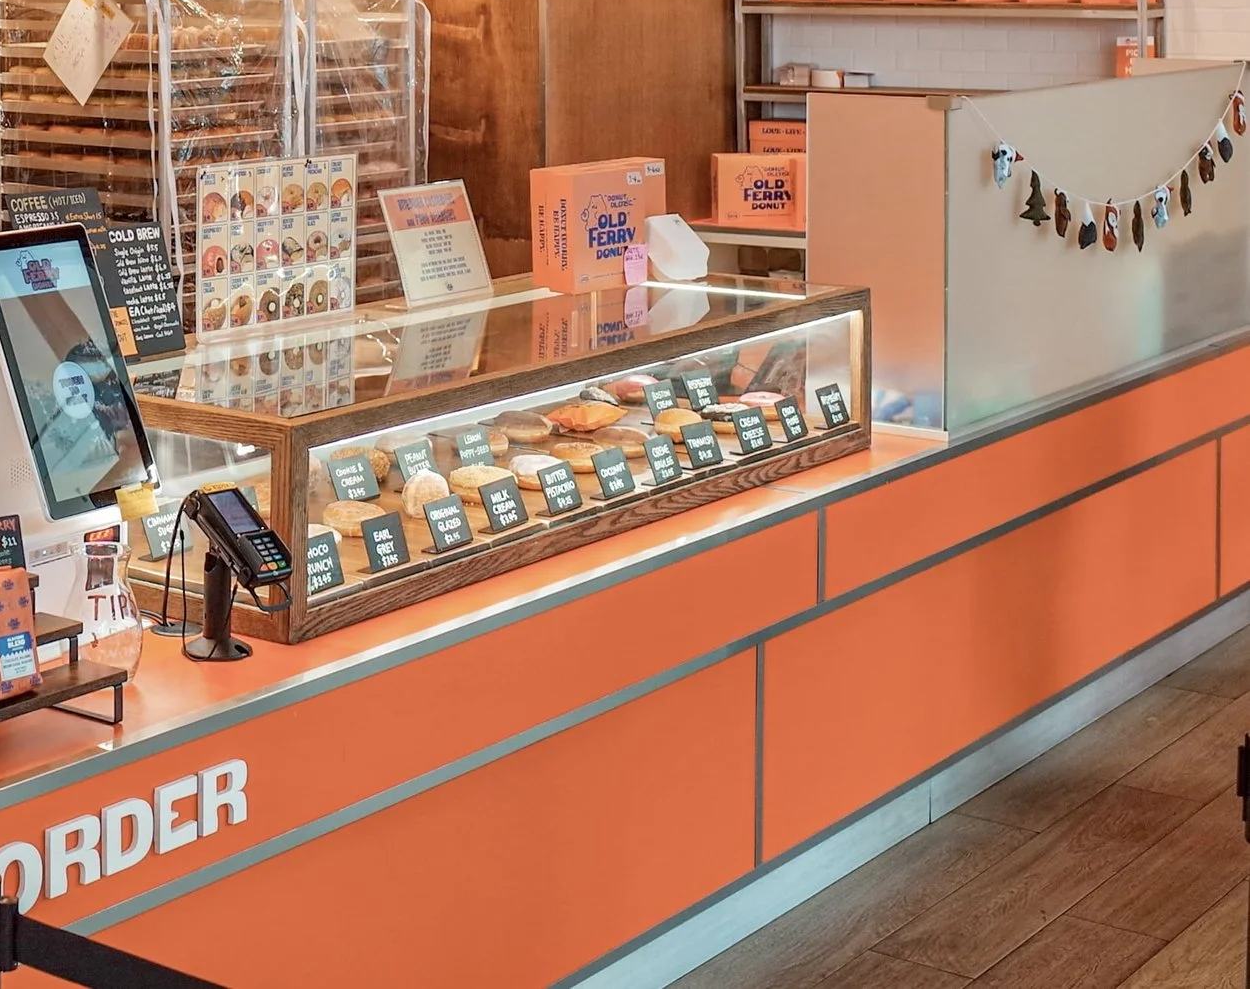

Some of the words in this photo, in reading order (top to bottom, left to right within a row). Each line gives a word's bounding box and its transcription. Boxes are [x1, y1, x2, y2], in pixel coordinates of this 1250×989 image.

[753, 179, 785, 190] OLD
[744, 187, 793, 201] FERRY
[10, 195, 48, 212] COFFEE
[751, 202, 786, 210] DONUT
[14, 212, 49, 224] ESPRESSO
[597, 211, 628, 230] OLD
[109, 229, 135, 243] COLD
[136, 227, 161, 241] BREW
[588, 227, 636, 248] FERRY
[739, 416, 761, 428] CREAM
[405, 449, 427, 464] PEANUT
[335, 466, 358, 477] COOKIE
[544, 468, 568, 485] BUTTER
[341, 475, 365, 487] CREAM
[490, 489, 510, 504] MILK
[545, 481, 576, 499] PISTACHIO
[429, 505, 460, 521] ORIGINAL
[492, 500, 517, 515] CREAM
[147, 511, 179, 528] CINNAMO
[437, 518, 461, 532] GLAZED
[373, 528, 393, 542] EARL
[307, 543, 329, 559] HOCO
[376, 541, 395, 557] GREY
[307, 557, 334, 576] RUNCH
